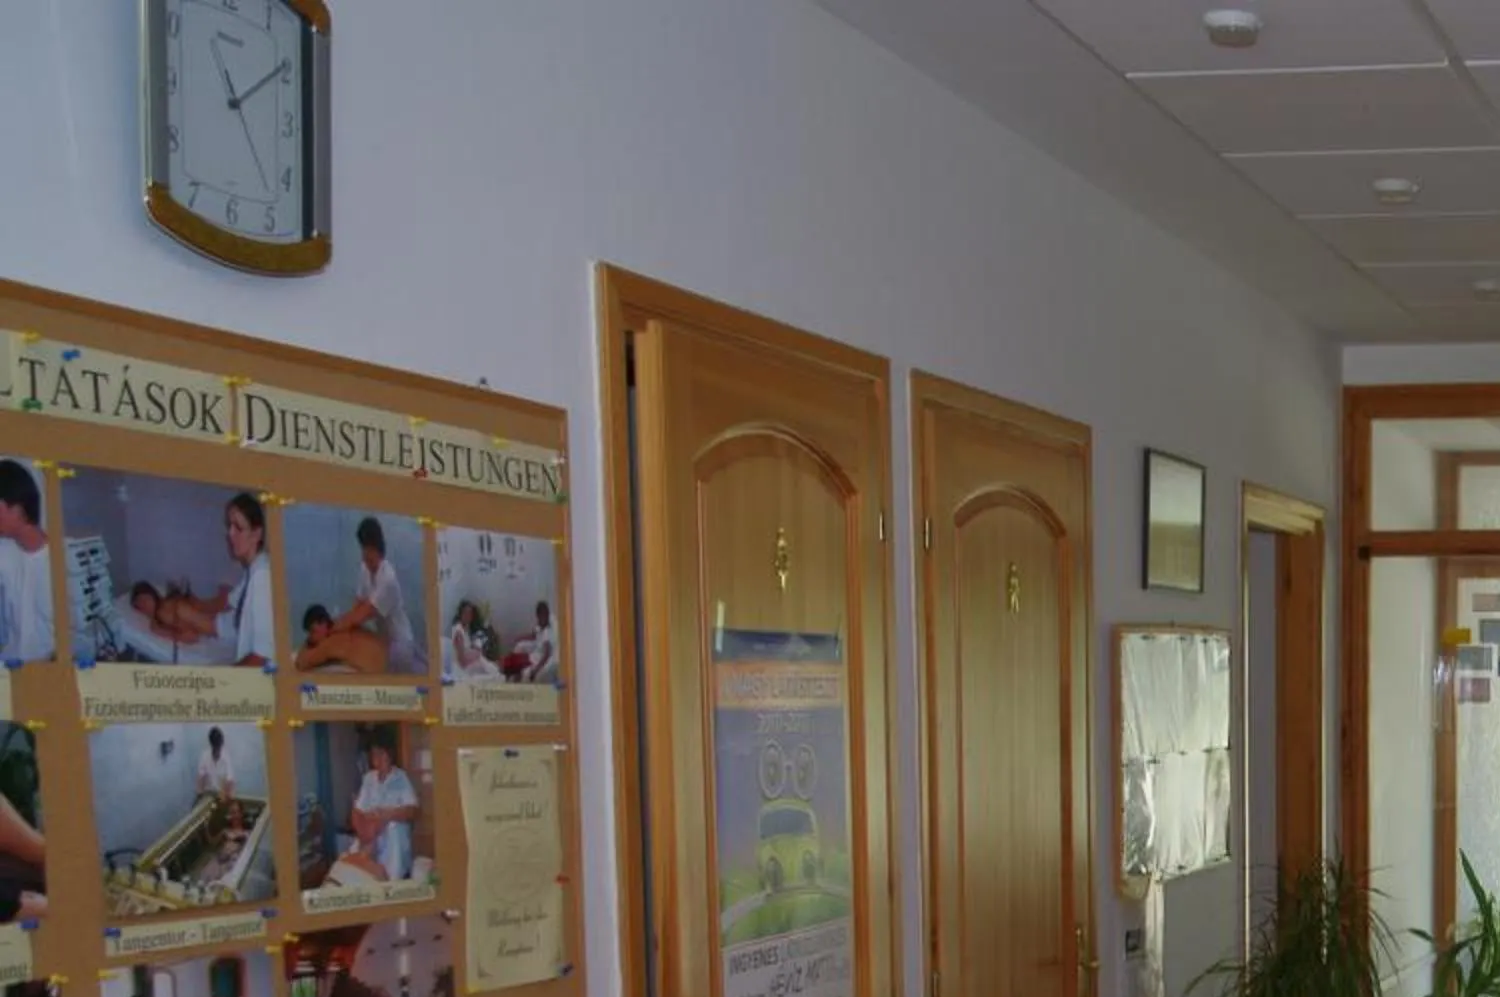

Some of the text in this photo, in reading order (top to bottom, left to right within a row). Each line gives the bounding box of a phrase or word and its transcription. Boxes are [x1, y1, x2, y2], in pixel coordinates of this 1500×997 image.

[280, 57, 291, 85] 2
[167, 124, 179, 153] 8
[281, 111, 294, 139] 3
[280, 165, 292, 192] 4
[187, 180, 202, 209] 7
[225, 194, 239, 225] 6
[263, 205, 276, 232] 5
